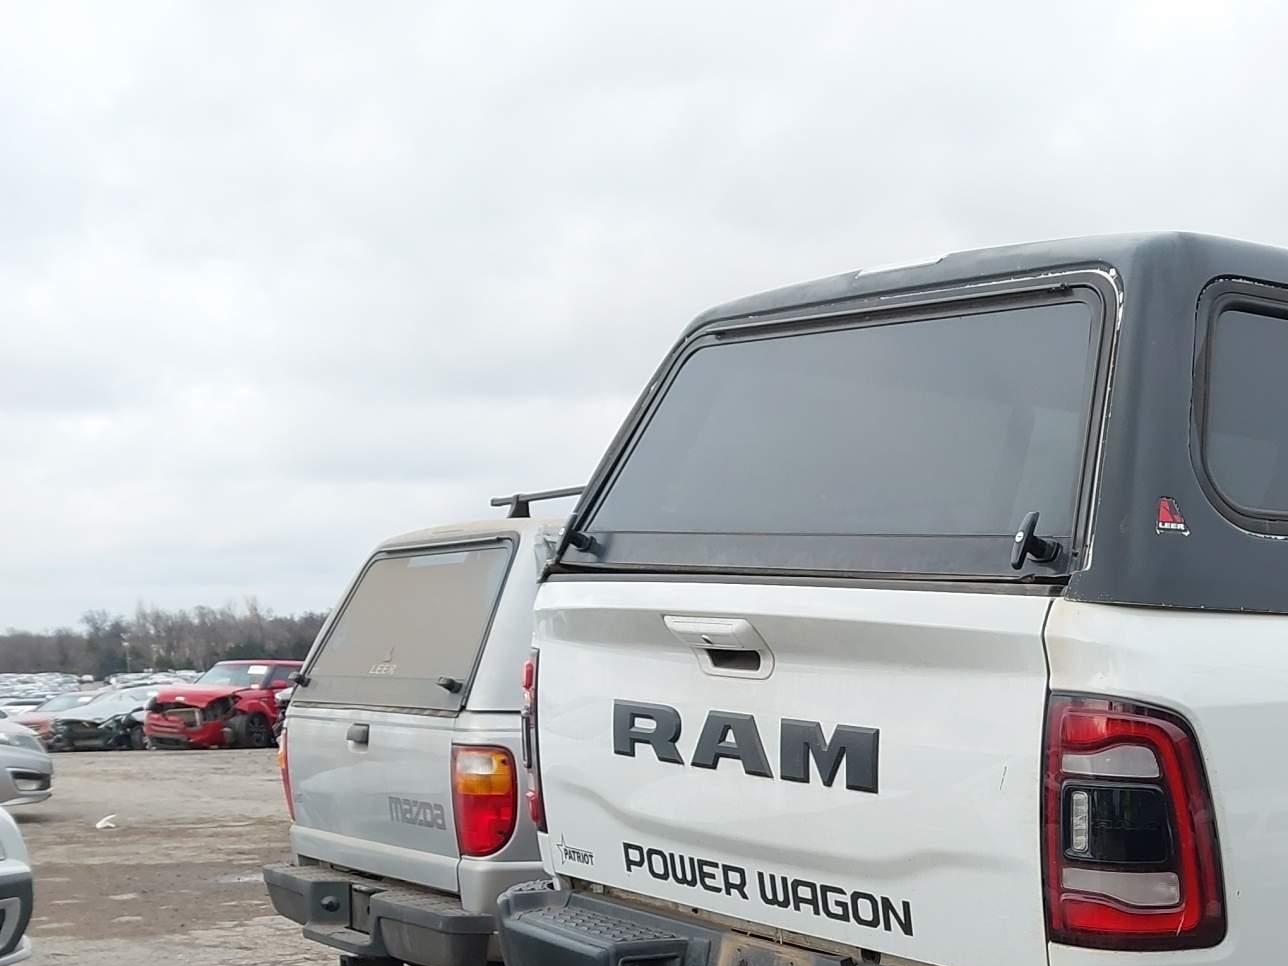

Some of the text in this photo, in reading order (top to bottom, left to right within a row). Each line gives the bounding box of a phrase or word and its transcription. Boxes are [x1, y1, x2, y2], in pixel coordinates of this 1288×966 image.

[613, 699, 880, 794] RAM
[563, 848, 594, 866] PATRIOT
[623, 842, 914, 936] POWER WAGON
